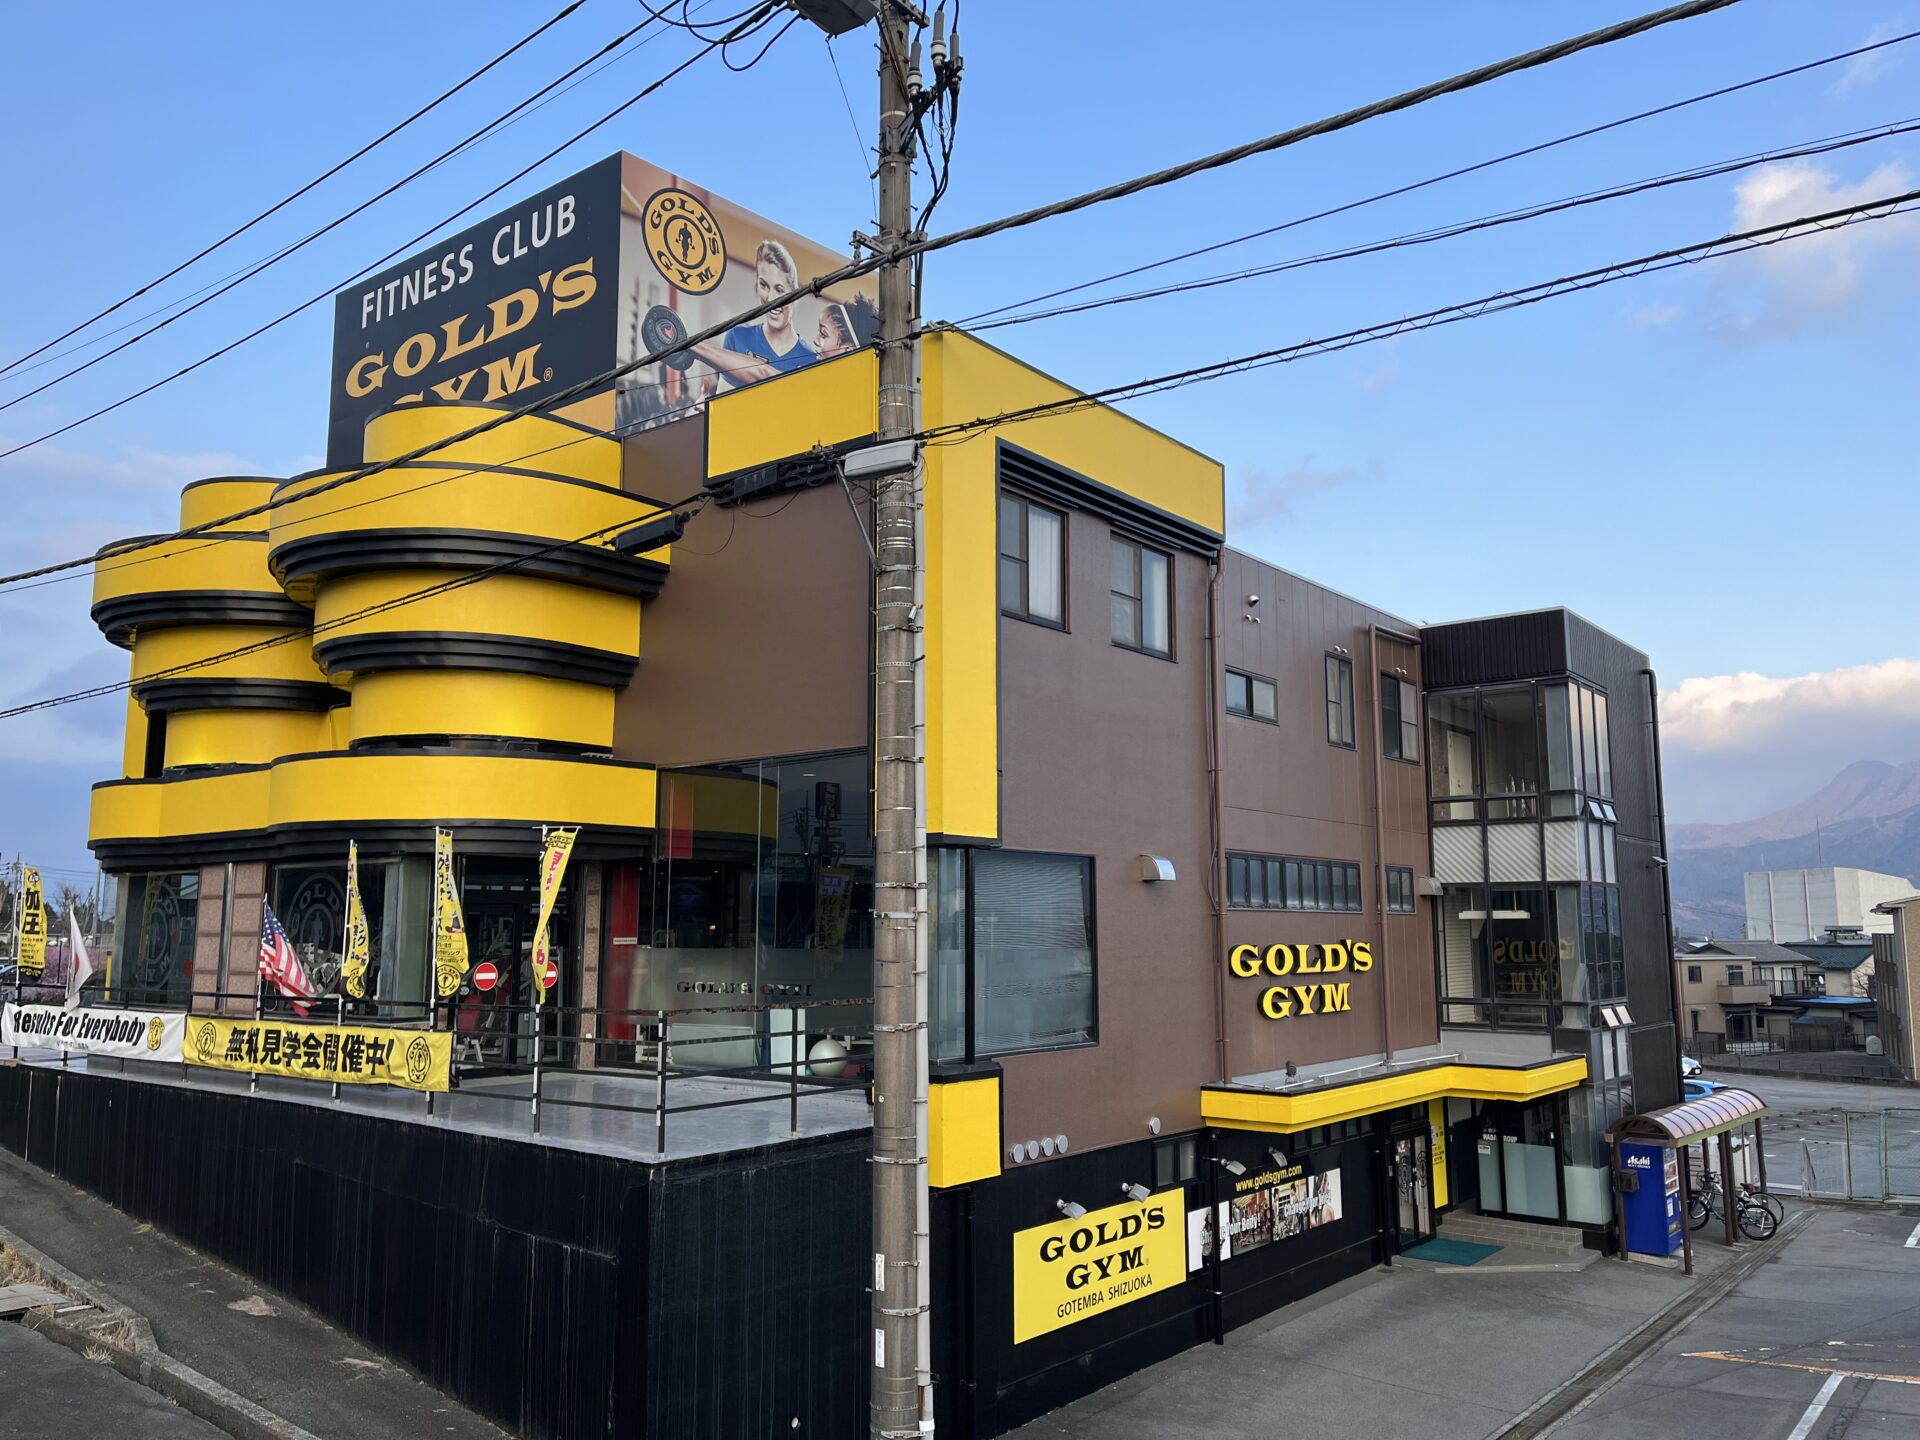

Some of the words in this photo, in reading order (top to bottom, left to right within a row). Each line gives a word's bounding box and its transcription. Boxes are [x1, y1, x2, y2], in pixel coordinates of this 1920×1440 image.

[650, 197, 720, 256] GOLD'S
[361, 243, 473, 329] FITNESS
[491, 195, 576, 266] CLUB
[656, 250, 716, 286] GYM
[345, 256, 597, 398] GOLD'S
[393, 343, 542, 405] YM
[21, 887, 41, 935] 加圧
[1229, 938, 1373, 978] GOLD'S
[677, 981, 753, 995] GOLD'S
[1259, 982, 1352, 1020] GYM
[14, 1010, 56, 1035] Results
[54, 1012, 79, 1037] For
[76, 1012, 146, 1047] Everybody
[1235, 1164, 1302, 1193] www.goldsgym.com
[1627, 1155, 1651, 1166] Asahi
[1039, 1205, 1165, 1263] GOLD'S
[1065, 1245, 1145, 1291] GYM
[1057, 1292, 1104, 1319] GOTEMBA
[1108, 1273, 1153, 1300] SHIZUOKA
